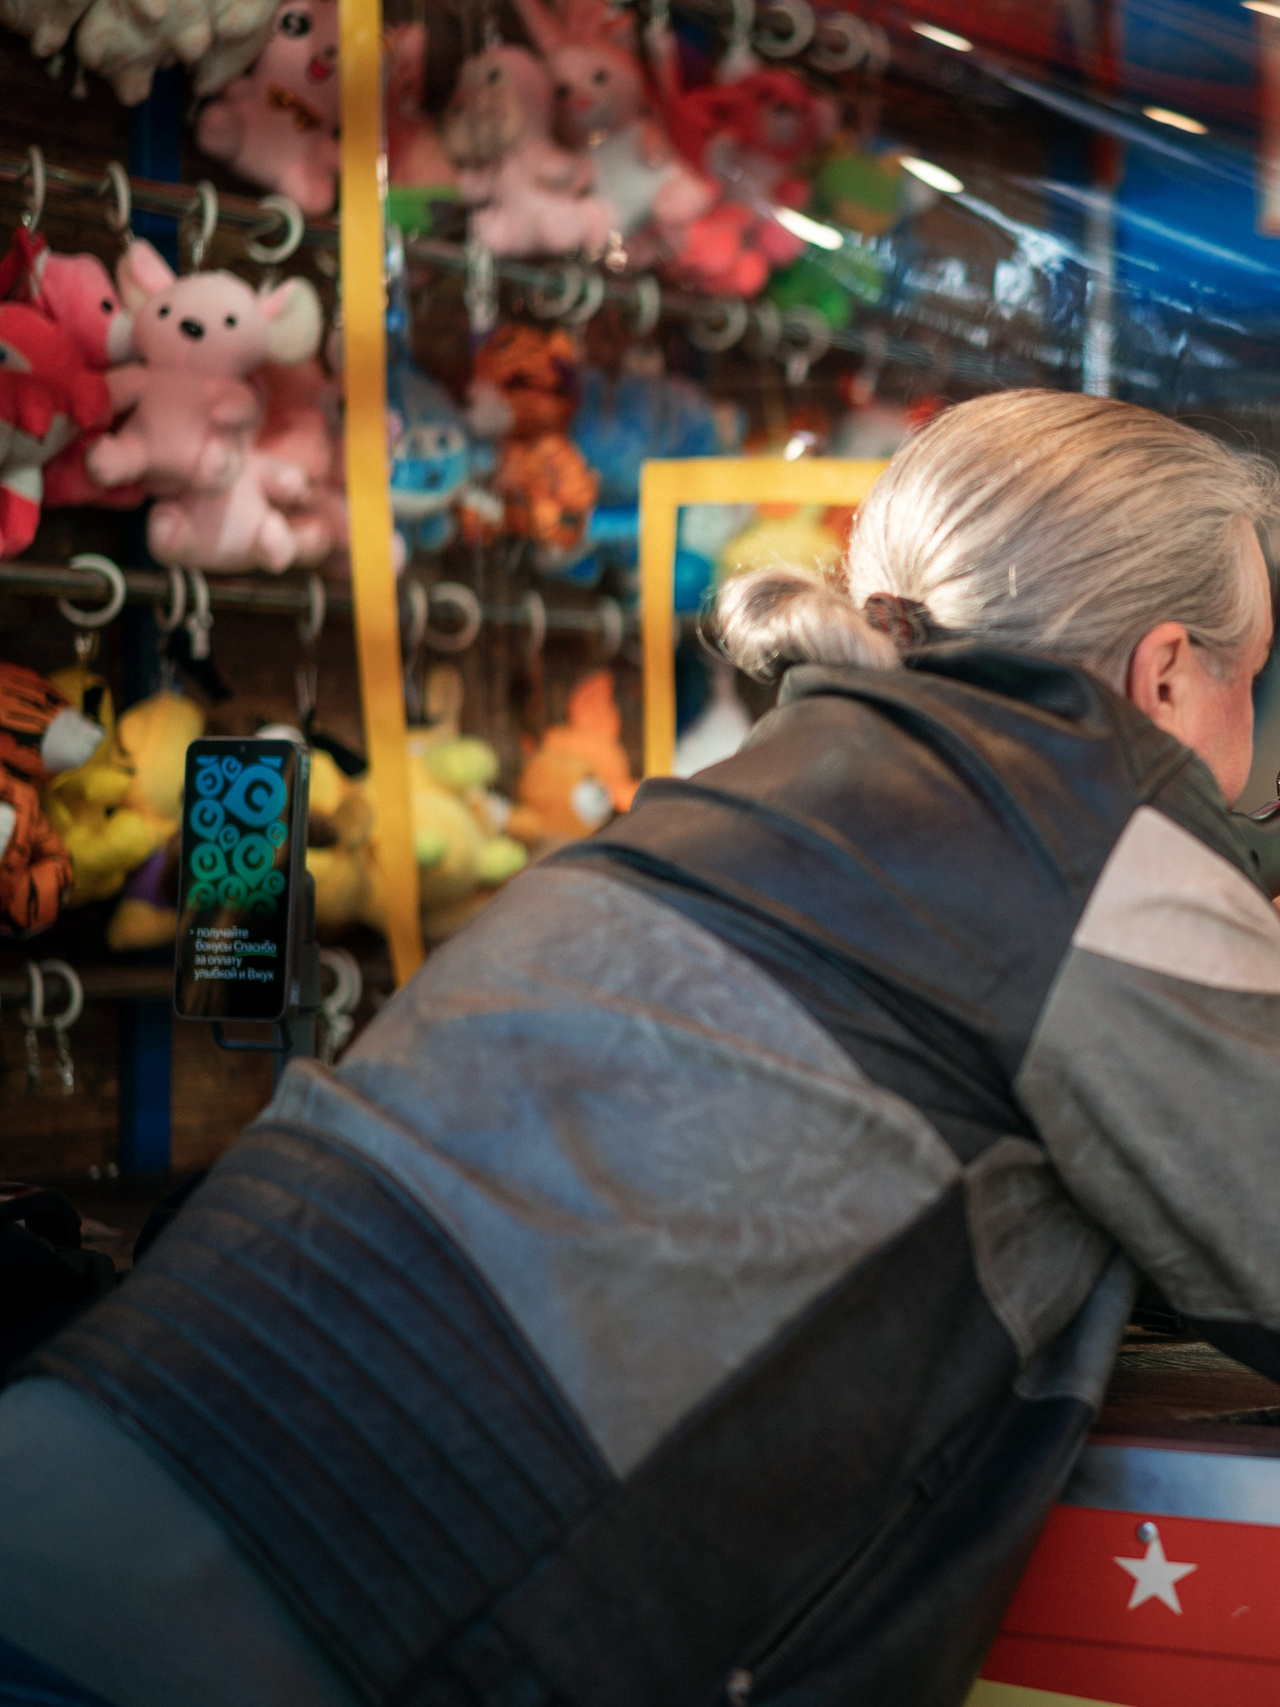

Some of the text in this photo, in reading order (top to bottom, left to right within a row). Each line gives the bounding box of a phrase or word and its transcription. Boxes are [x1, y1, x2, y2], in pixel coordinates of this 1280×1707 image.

[197, 926, 249, 940] получайте
[195, 939, 277, 954] бонусы Спасибо
[195, 955, 242, 967] за оплату
[194, 966, 274, 983] улыбкой и Вжух
